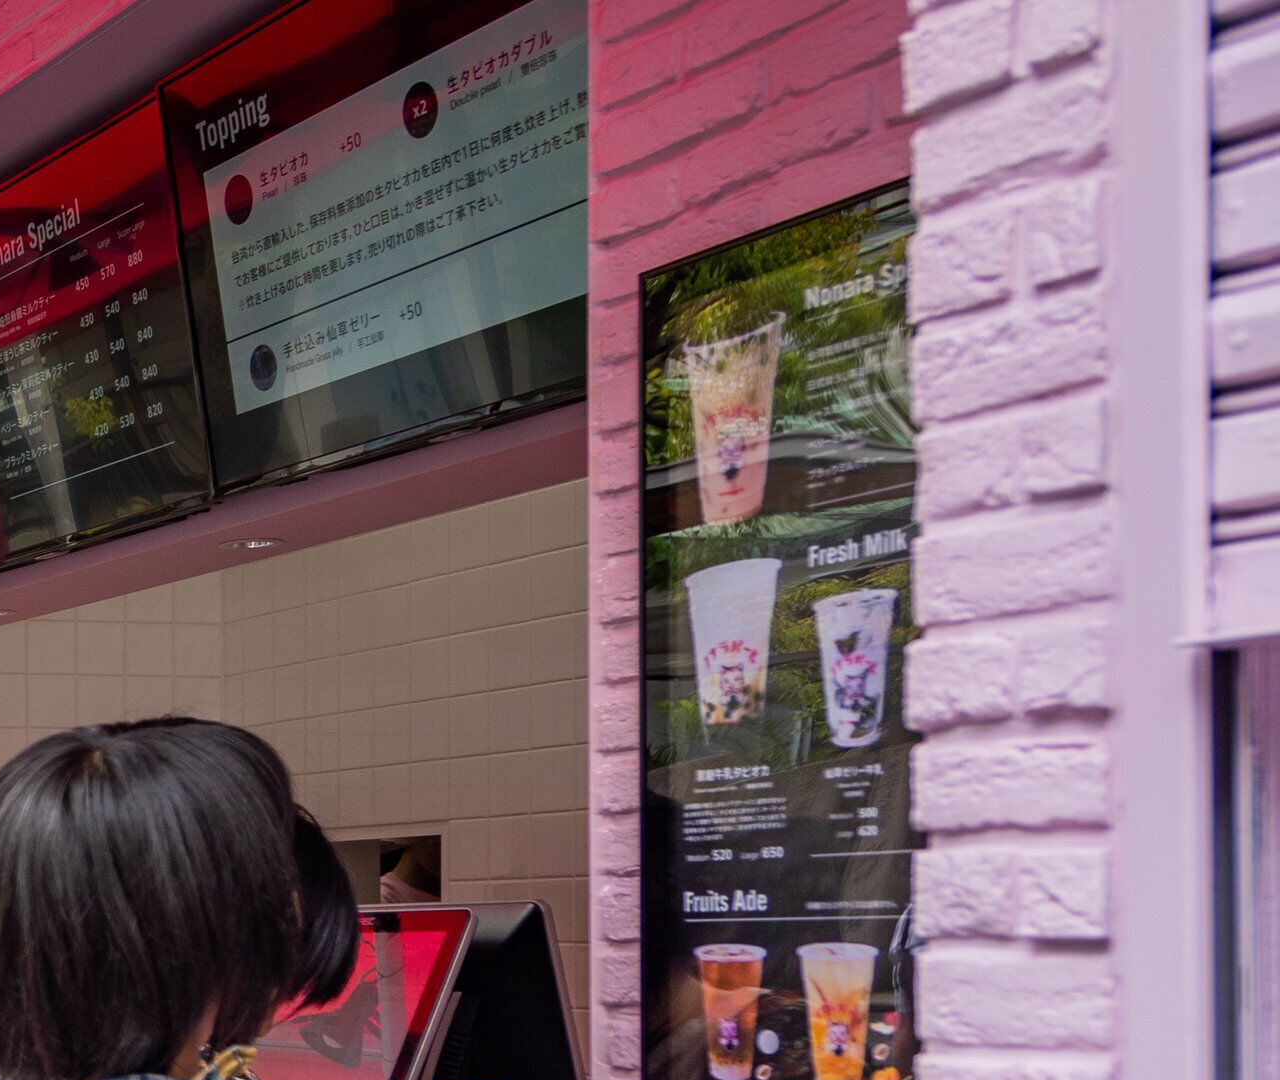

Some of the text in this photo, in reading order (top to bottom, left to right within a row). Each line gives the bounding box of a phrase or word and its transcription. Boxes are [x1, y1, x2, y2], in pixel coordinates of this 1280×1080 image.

[195, 93, 271, 151] Topping
[412, 99, 428, 119] x2
[339, 132, 362, 153] +50
[259, 151, 309, 187] 生タピオカ
[27, 199, 81, 252] Special
[74, 276, 90, 292] 450
[100, 263, 116, 281] 570
[804, 275, 874, 310] Nonara
[80, 312, 94, 328] 430
[104, 300, 120, 318] 540
[132, 287, 148, 305] 840
[399, 301, 423, 321] +50
[84, 349, 99, 365] 430
[109, 338, 125, 355] 540
[137, 326, 153, 343] 840
[114, 375, 130, 392] 540
[142, 363, 158, 381] 840
[94, 422, 109, 439] 420
[119, 412, 135, 429] 530
[147, 402, 163, 419] 820
[806, 524, 909, 568] Fresh Milk
[710, 848, 733, 861] 520
[760, 846, 785, 859] 650
[684, 889, 768, 914] Fruits Ade
